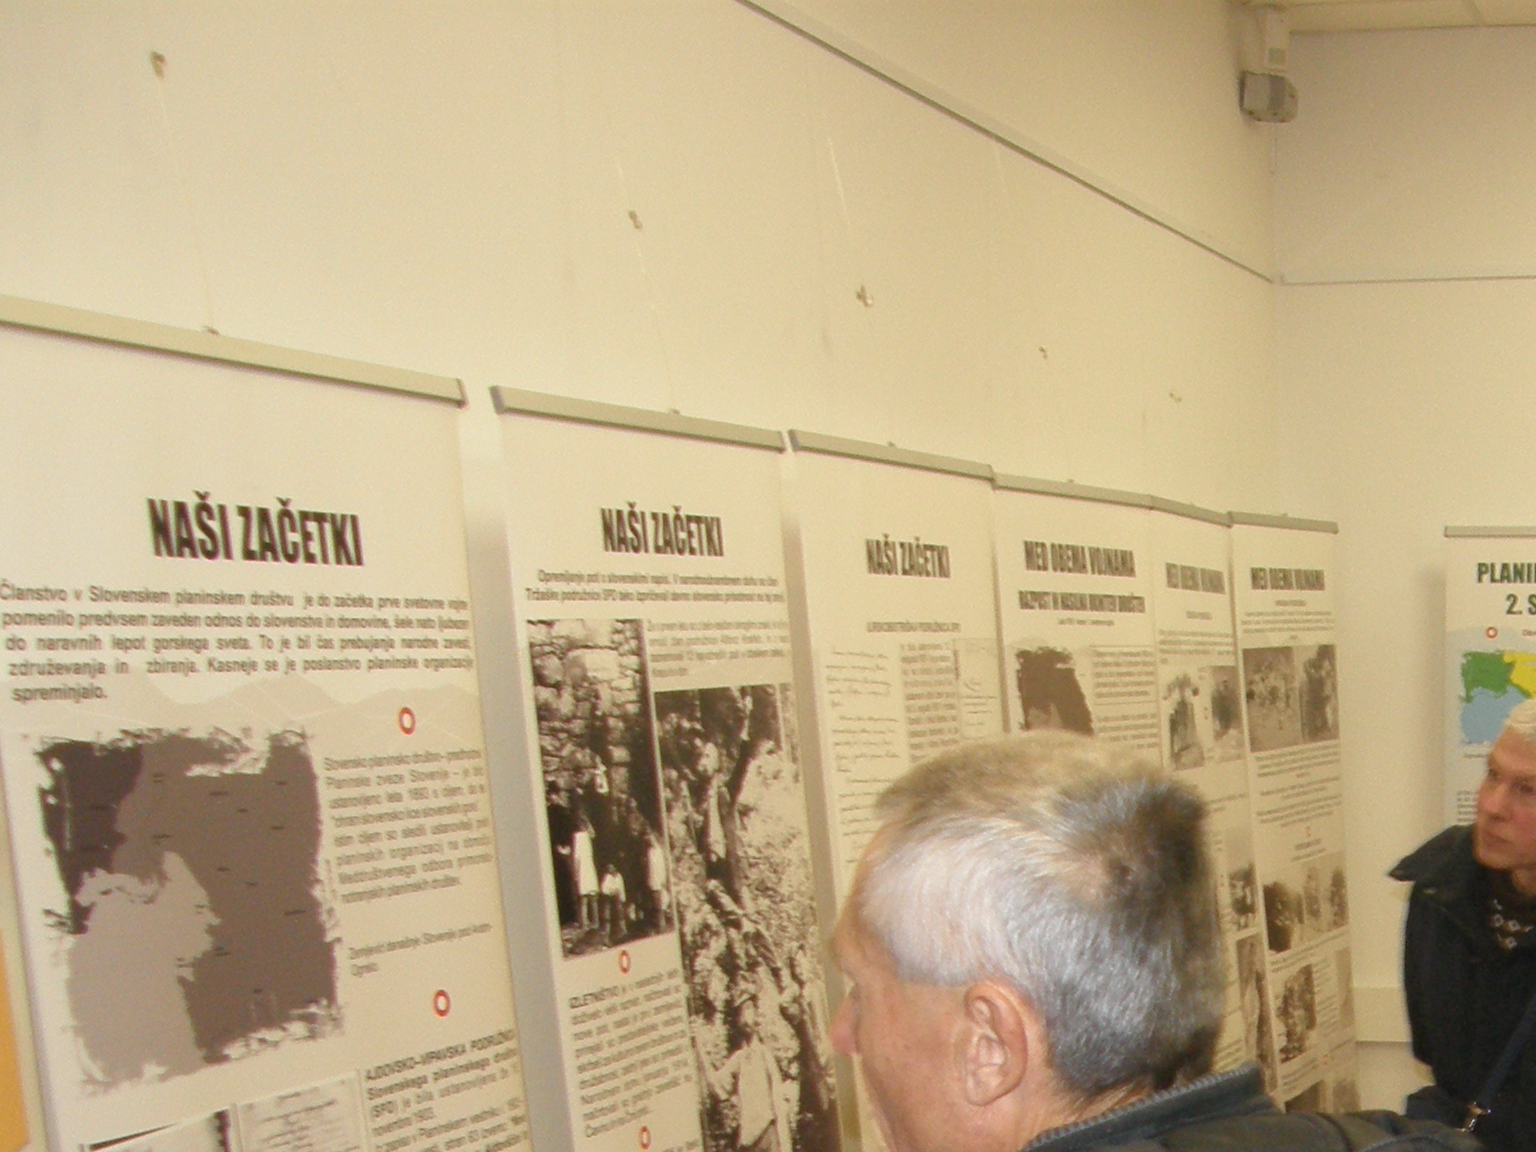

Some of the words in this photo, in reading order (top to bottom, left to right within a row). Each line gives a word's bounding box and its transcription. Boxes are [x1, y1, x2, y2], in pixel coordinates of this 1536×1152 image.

[147, 490, 233, 560] NAŠI
[237, 496, 364, 567] ZAČETKI
[600, 501, 650, 554] NAŠI
[651, 504, 723, 557] ZAČETKI
[865, 532, 898, 575] NAŠI
[899, 536, 950, 579] ZAČETKI
[1024, 540, 1049, 572] MED
[1051, 541, 1088, 574] OBEMA
[1088, 546, 1137, 578] VOJNAMA
[1251, 567, 1268, 591] MED
[1, 578, 67, 601] Članstvo
[73, 588, 82, 600] v
[89, 585, 170, 604] Slovenskem
[175, 589, 245, 606] planinskem
[250, 590, 294, 606] društvu
[303, 592, 314, 609] je
[318, 594, 331, 607] do
[1506, 593, 1524, 615] 2.
[3, 609, 75, 629] pomenilo
[79, 610, 148, 629] predvsem
[152, 612, 201, 627] zaveden
[204, 612, 243, 628] odnos
[247, 613, 261, 628] do
[6, 634, 27, 651] do
[36, 634, 103, 651] naravnih
[111, 634, 146, 653] lepot
[153, 635, 210, 653] gorskega
[259, 634, 274, 650] To
[280, 636, 291, 653] je
[9, 658, 106, 678] združevanja
[116, 658, 129, 674] in
[208, 657, 258, 675] Kasneje
[265, 660, 279, 673] se
[284, 659, 297, 674] je
[303, 656, 361, 673] poslanstvo
[13, 683, 108, 703] spreminjalo.
